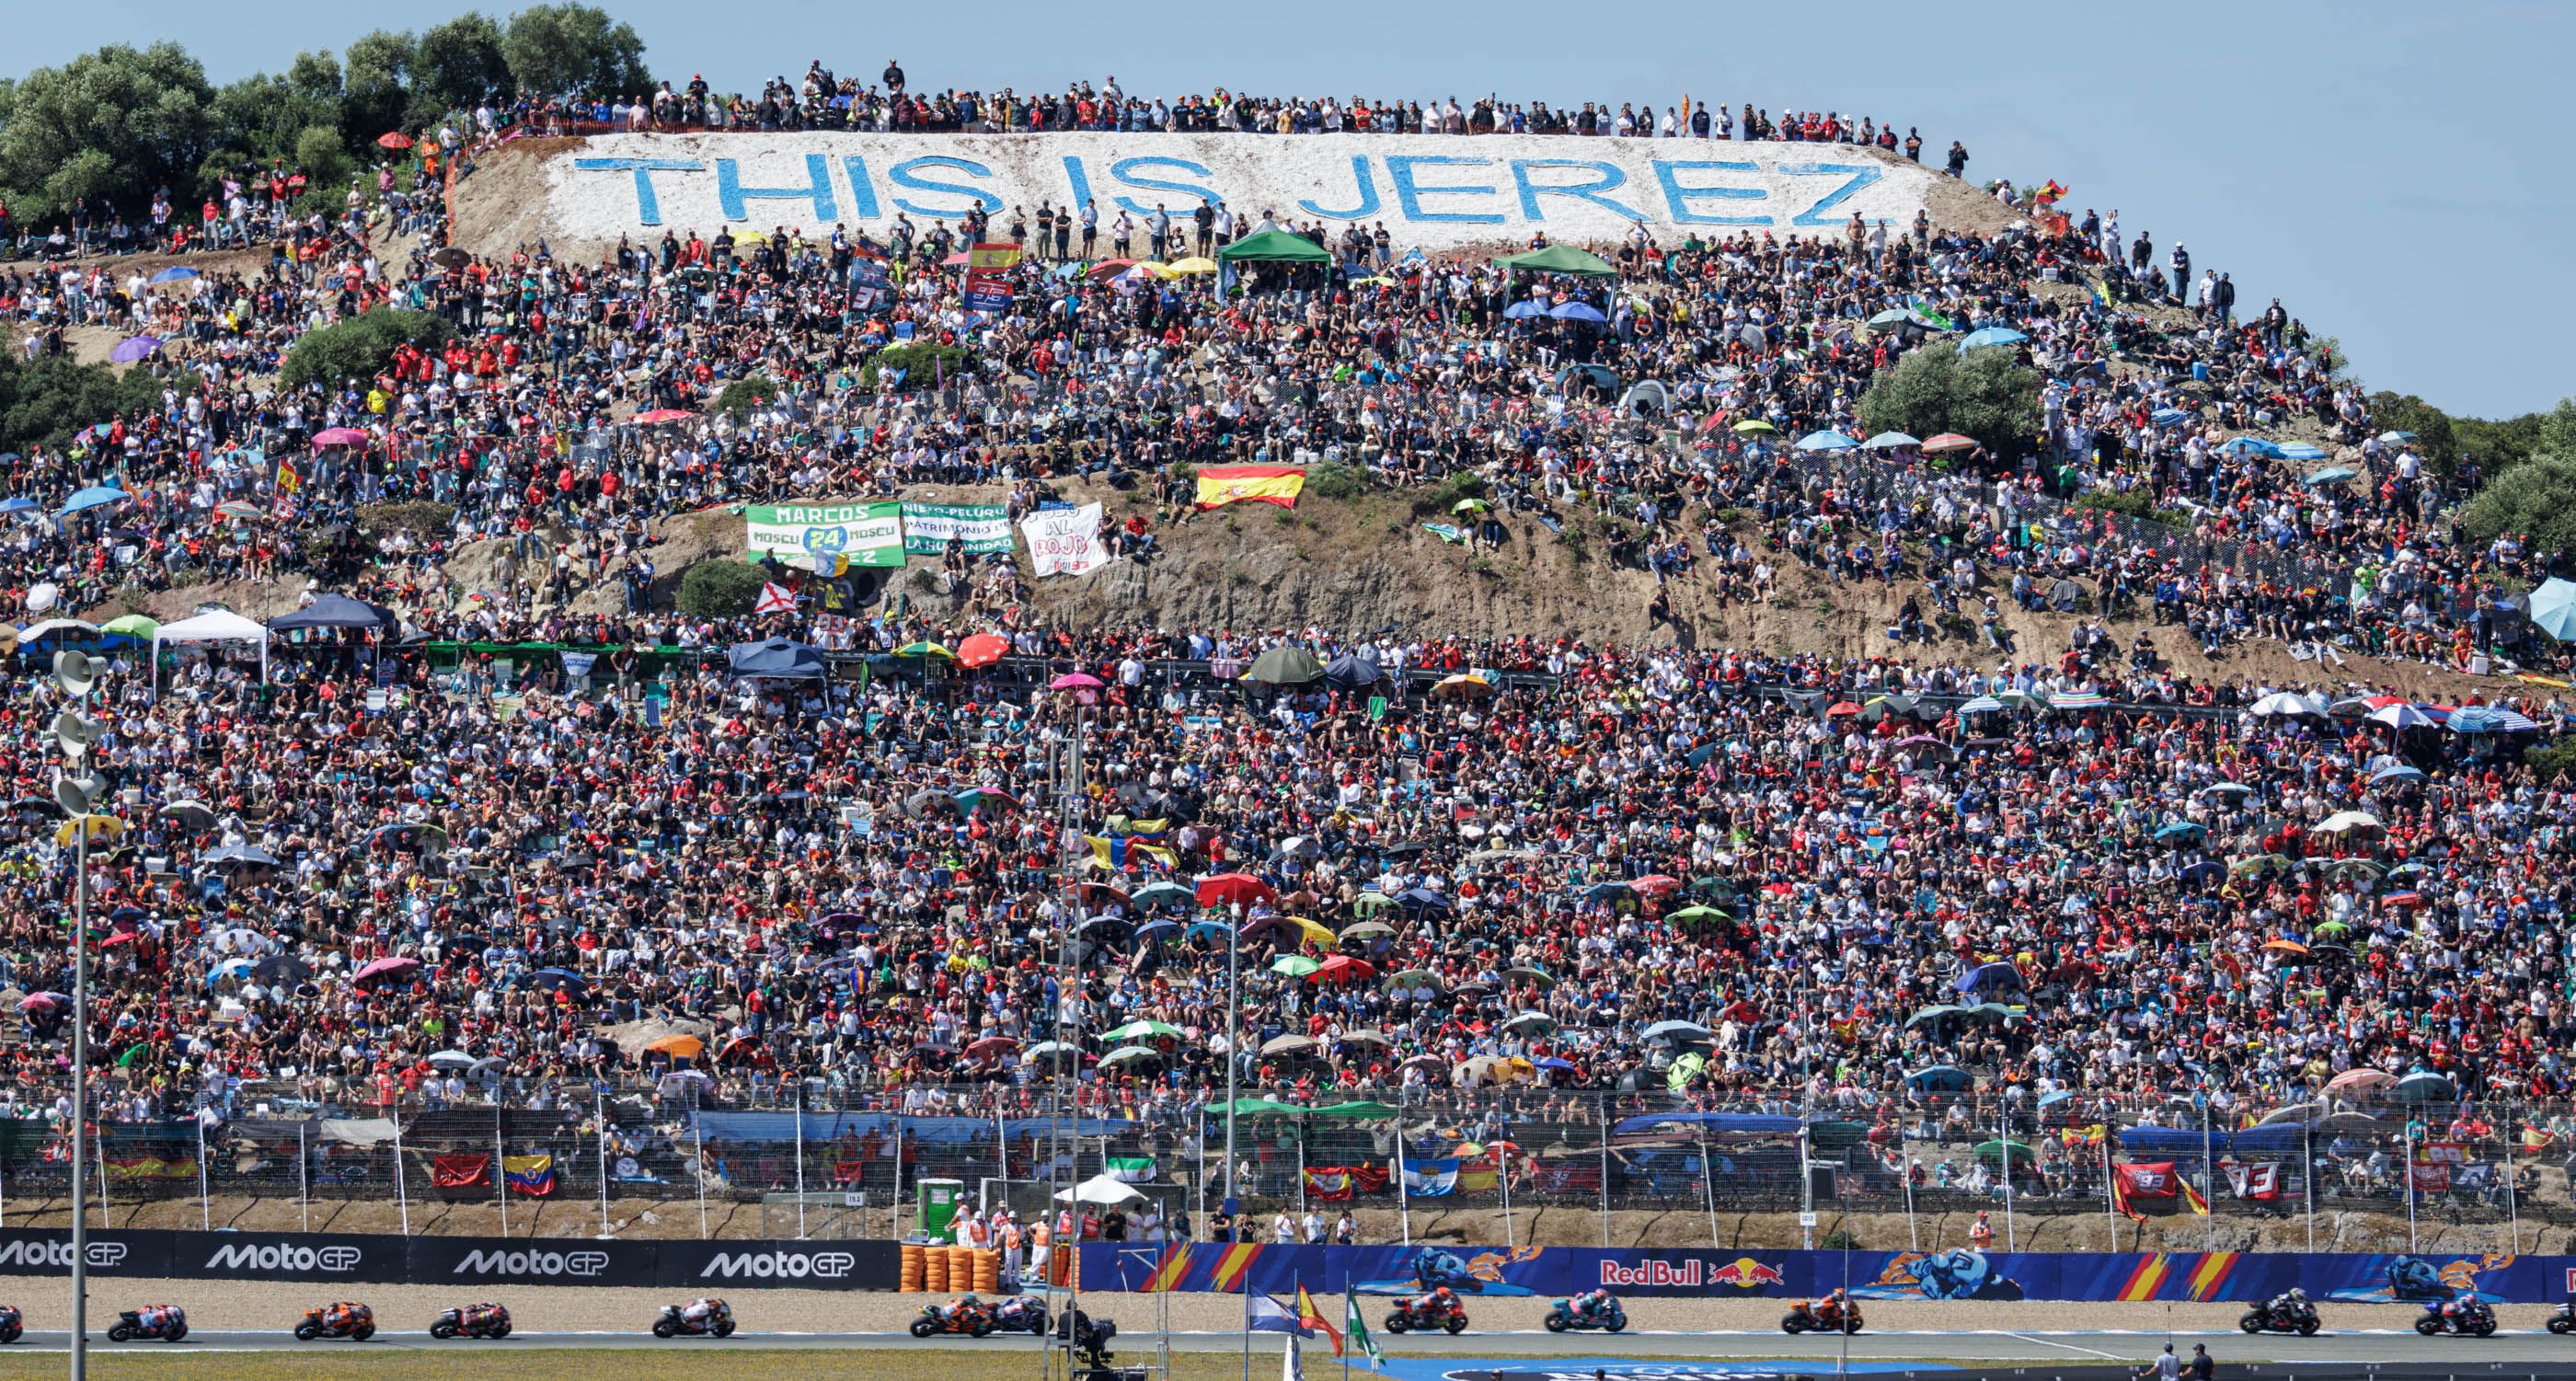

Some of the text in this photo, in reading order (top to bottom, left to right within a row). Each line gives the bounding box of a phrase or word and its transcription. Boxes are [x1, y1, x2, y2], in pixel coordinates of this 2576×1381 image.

[575, 153, 1896, 226] THIS IS JEREZ
[776, 506, 869, 524] MARCOS
[1045, 520, 1074, 535] AL
[753, 525, 895, 549] MOSCU 24 MOSCU
[905, 537, 1013, 552] LA HUANIDAD
[1035, 535, 1087, 558] ROJO
[204, 1243, 362, 1272] MotoGP
[453, 1249, 609, 1276] MotoGP
[699, 1250, 856, 1278] MotoGP
[1601, 1259, 1701, 1286] Red Bull
